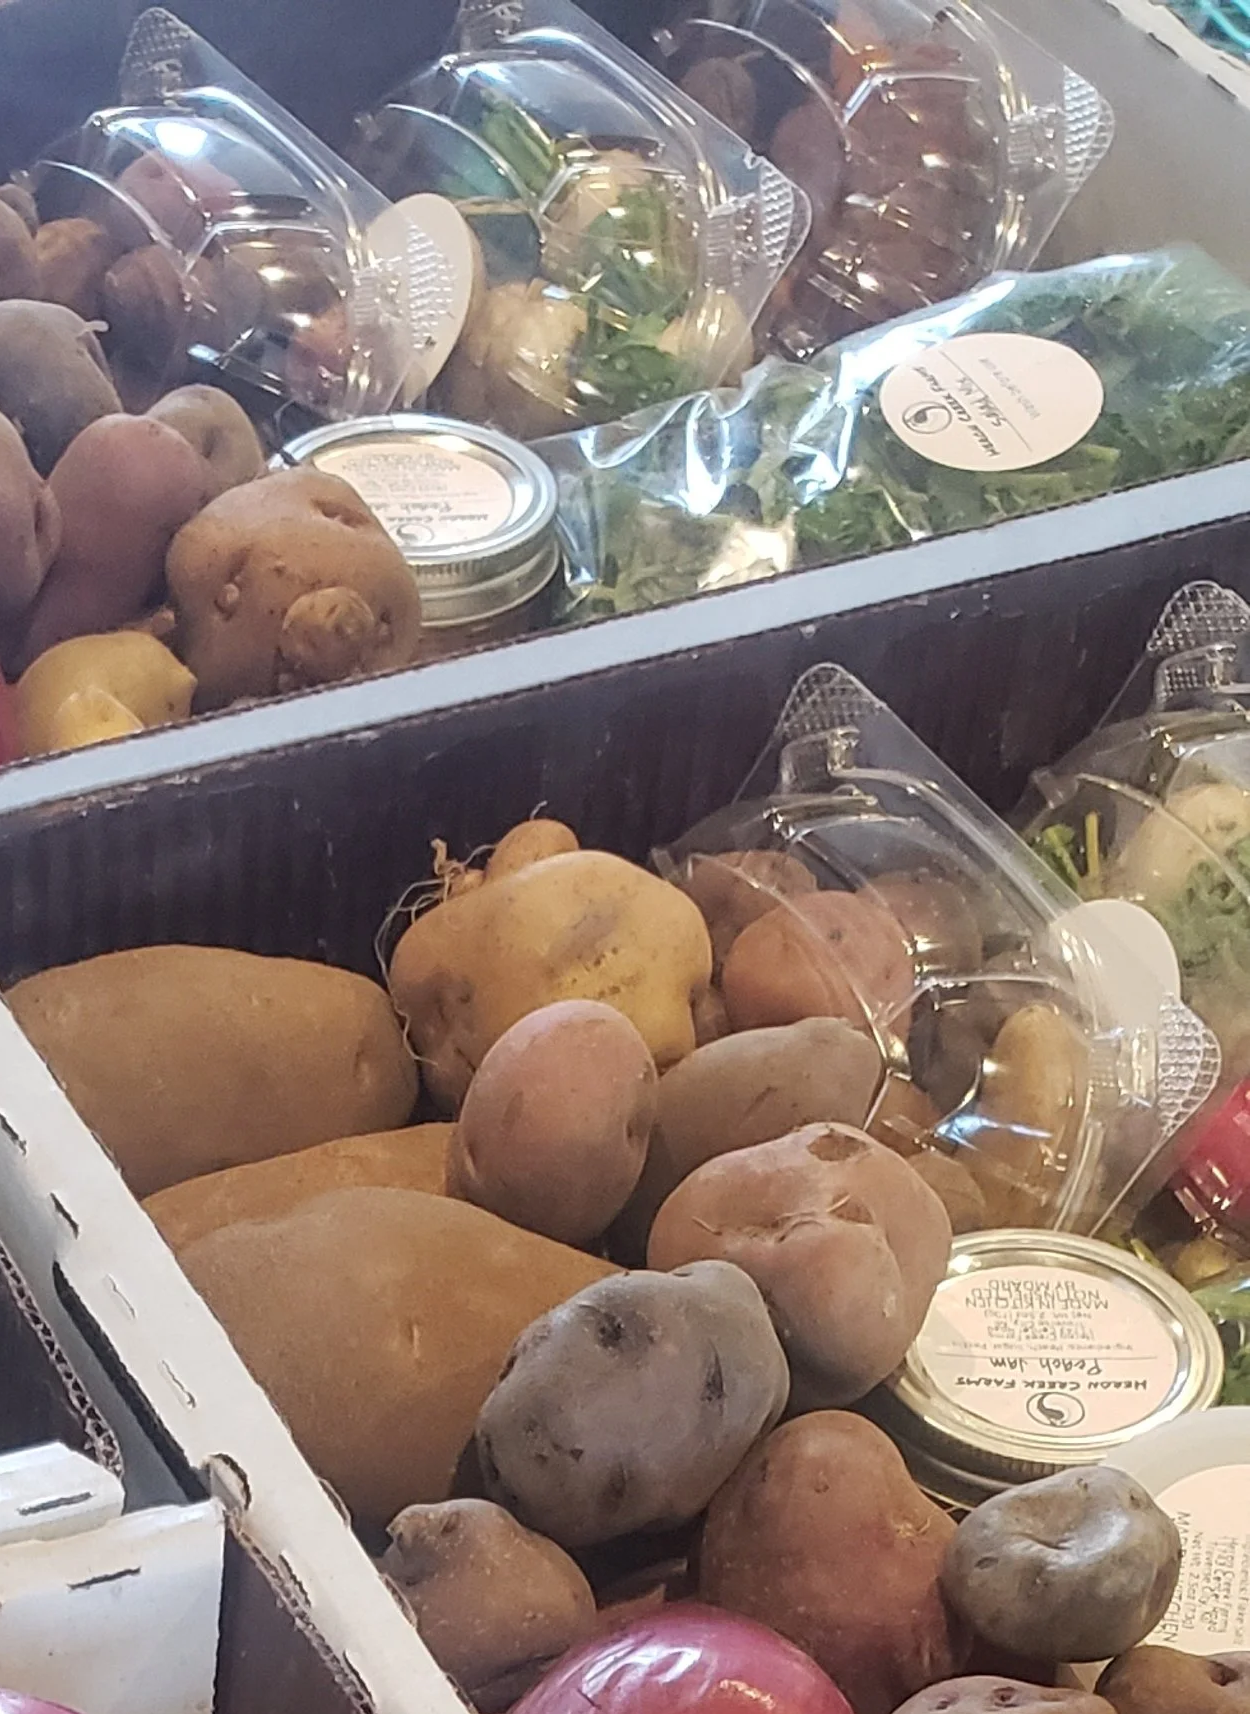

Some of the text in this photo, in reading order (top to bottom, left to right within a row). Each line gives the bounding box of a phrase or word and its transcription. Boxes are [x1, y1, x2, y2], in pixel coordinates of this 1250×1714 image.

[989, 1356, 1102, 1376] Peach Jam
[955, 1375, 1148, 1391] HERON CREEK FARMS
